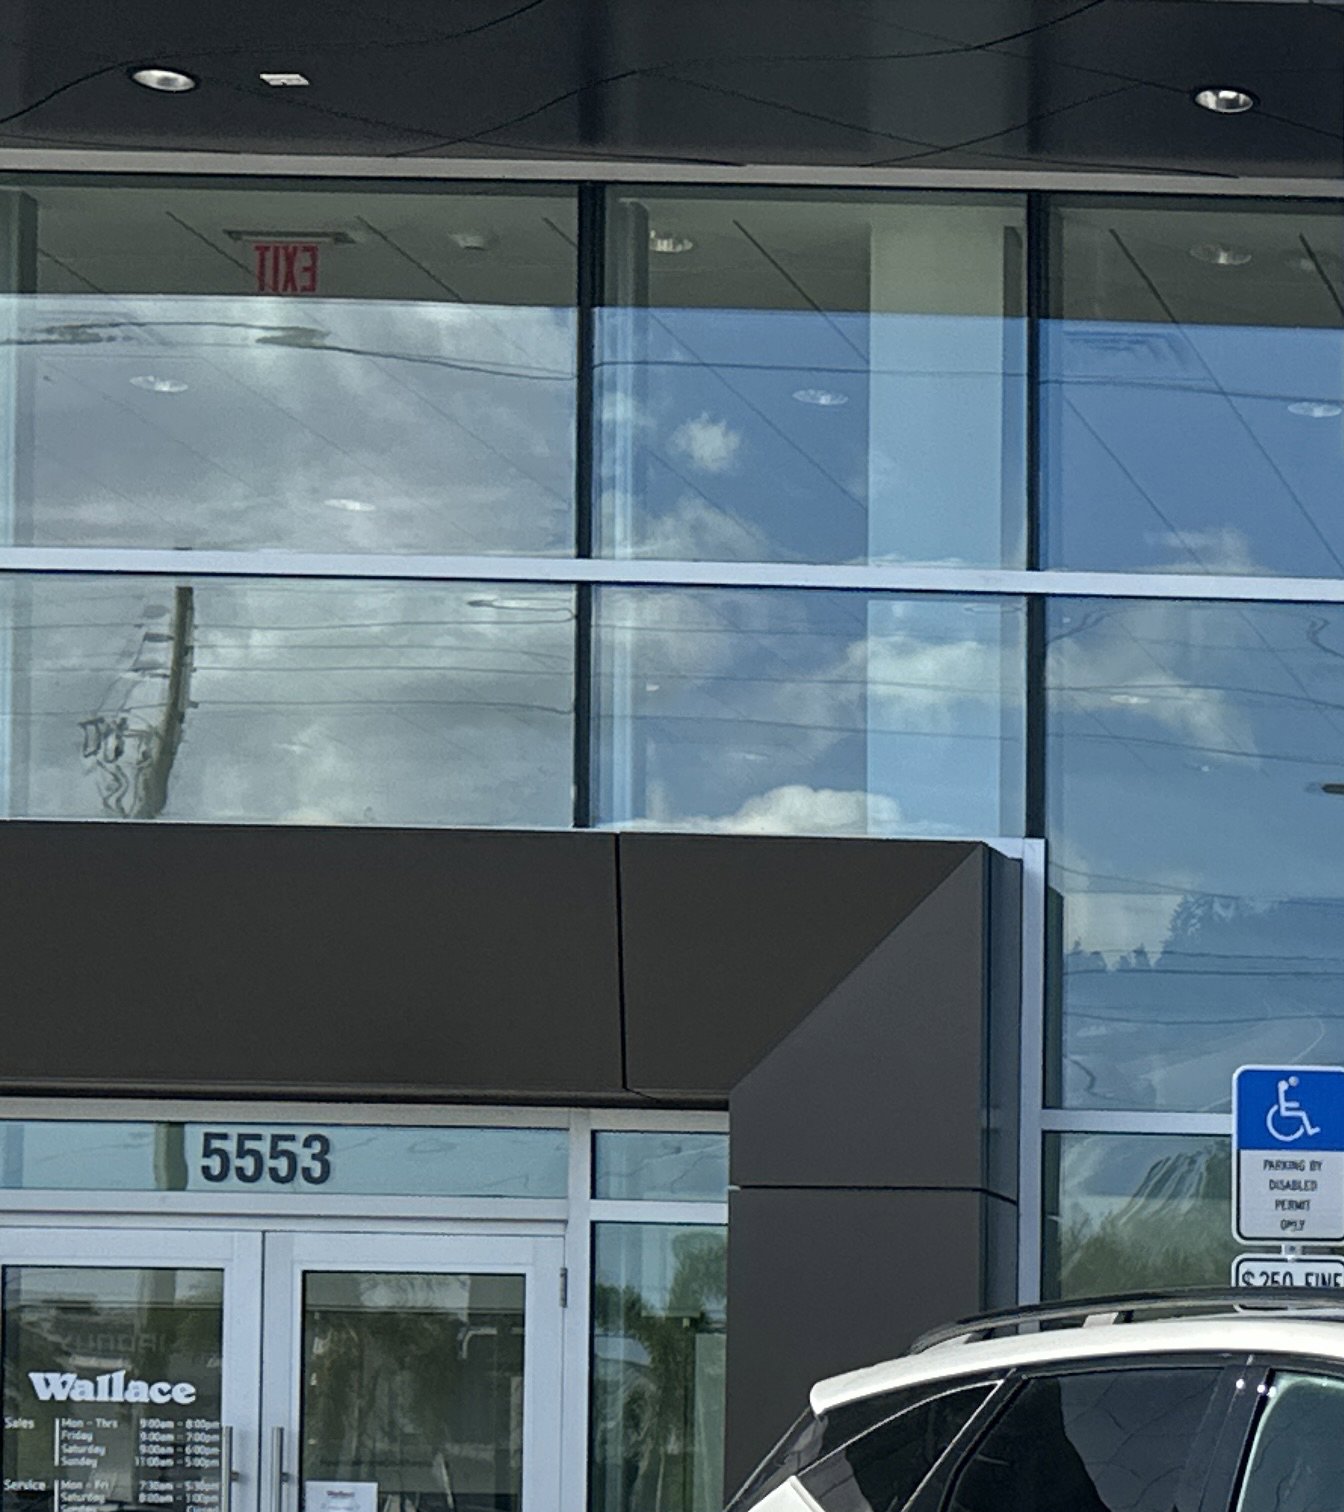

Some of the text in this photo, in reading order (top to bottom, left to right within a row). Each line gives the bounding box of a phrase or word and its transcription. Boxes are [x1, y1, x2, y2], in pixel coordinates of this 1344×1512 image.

[200, 1132, 332, 1185] 5553
[1263, 1160, 1322, 1171] PARKING BY
[1269, 1179, 1318, 1191] DISABLED
[1275, 1200, 1310, 1211] PERMIT
[28, 1370, 196, 1405] Wallace
[4, 1417, 34, 1429] Sales
[62, 1418, 83, 1428] Mon
[62, 1430, 93, 1443] Friday
[62, 1443, 106, 1456] Saturday
[62, 1456, 97, 1468] Sunday
[4, 1479, 46, 1491] Service
